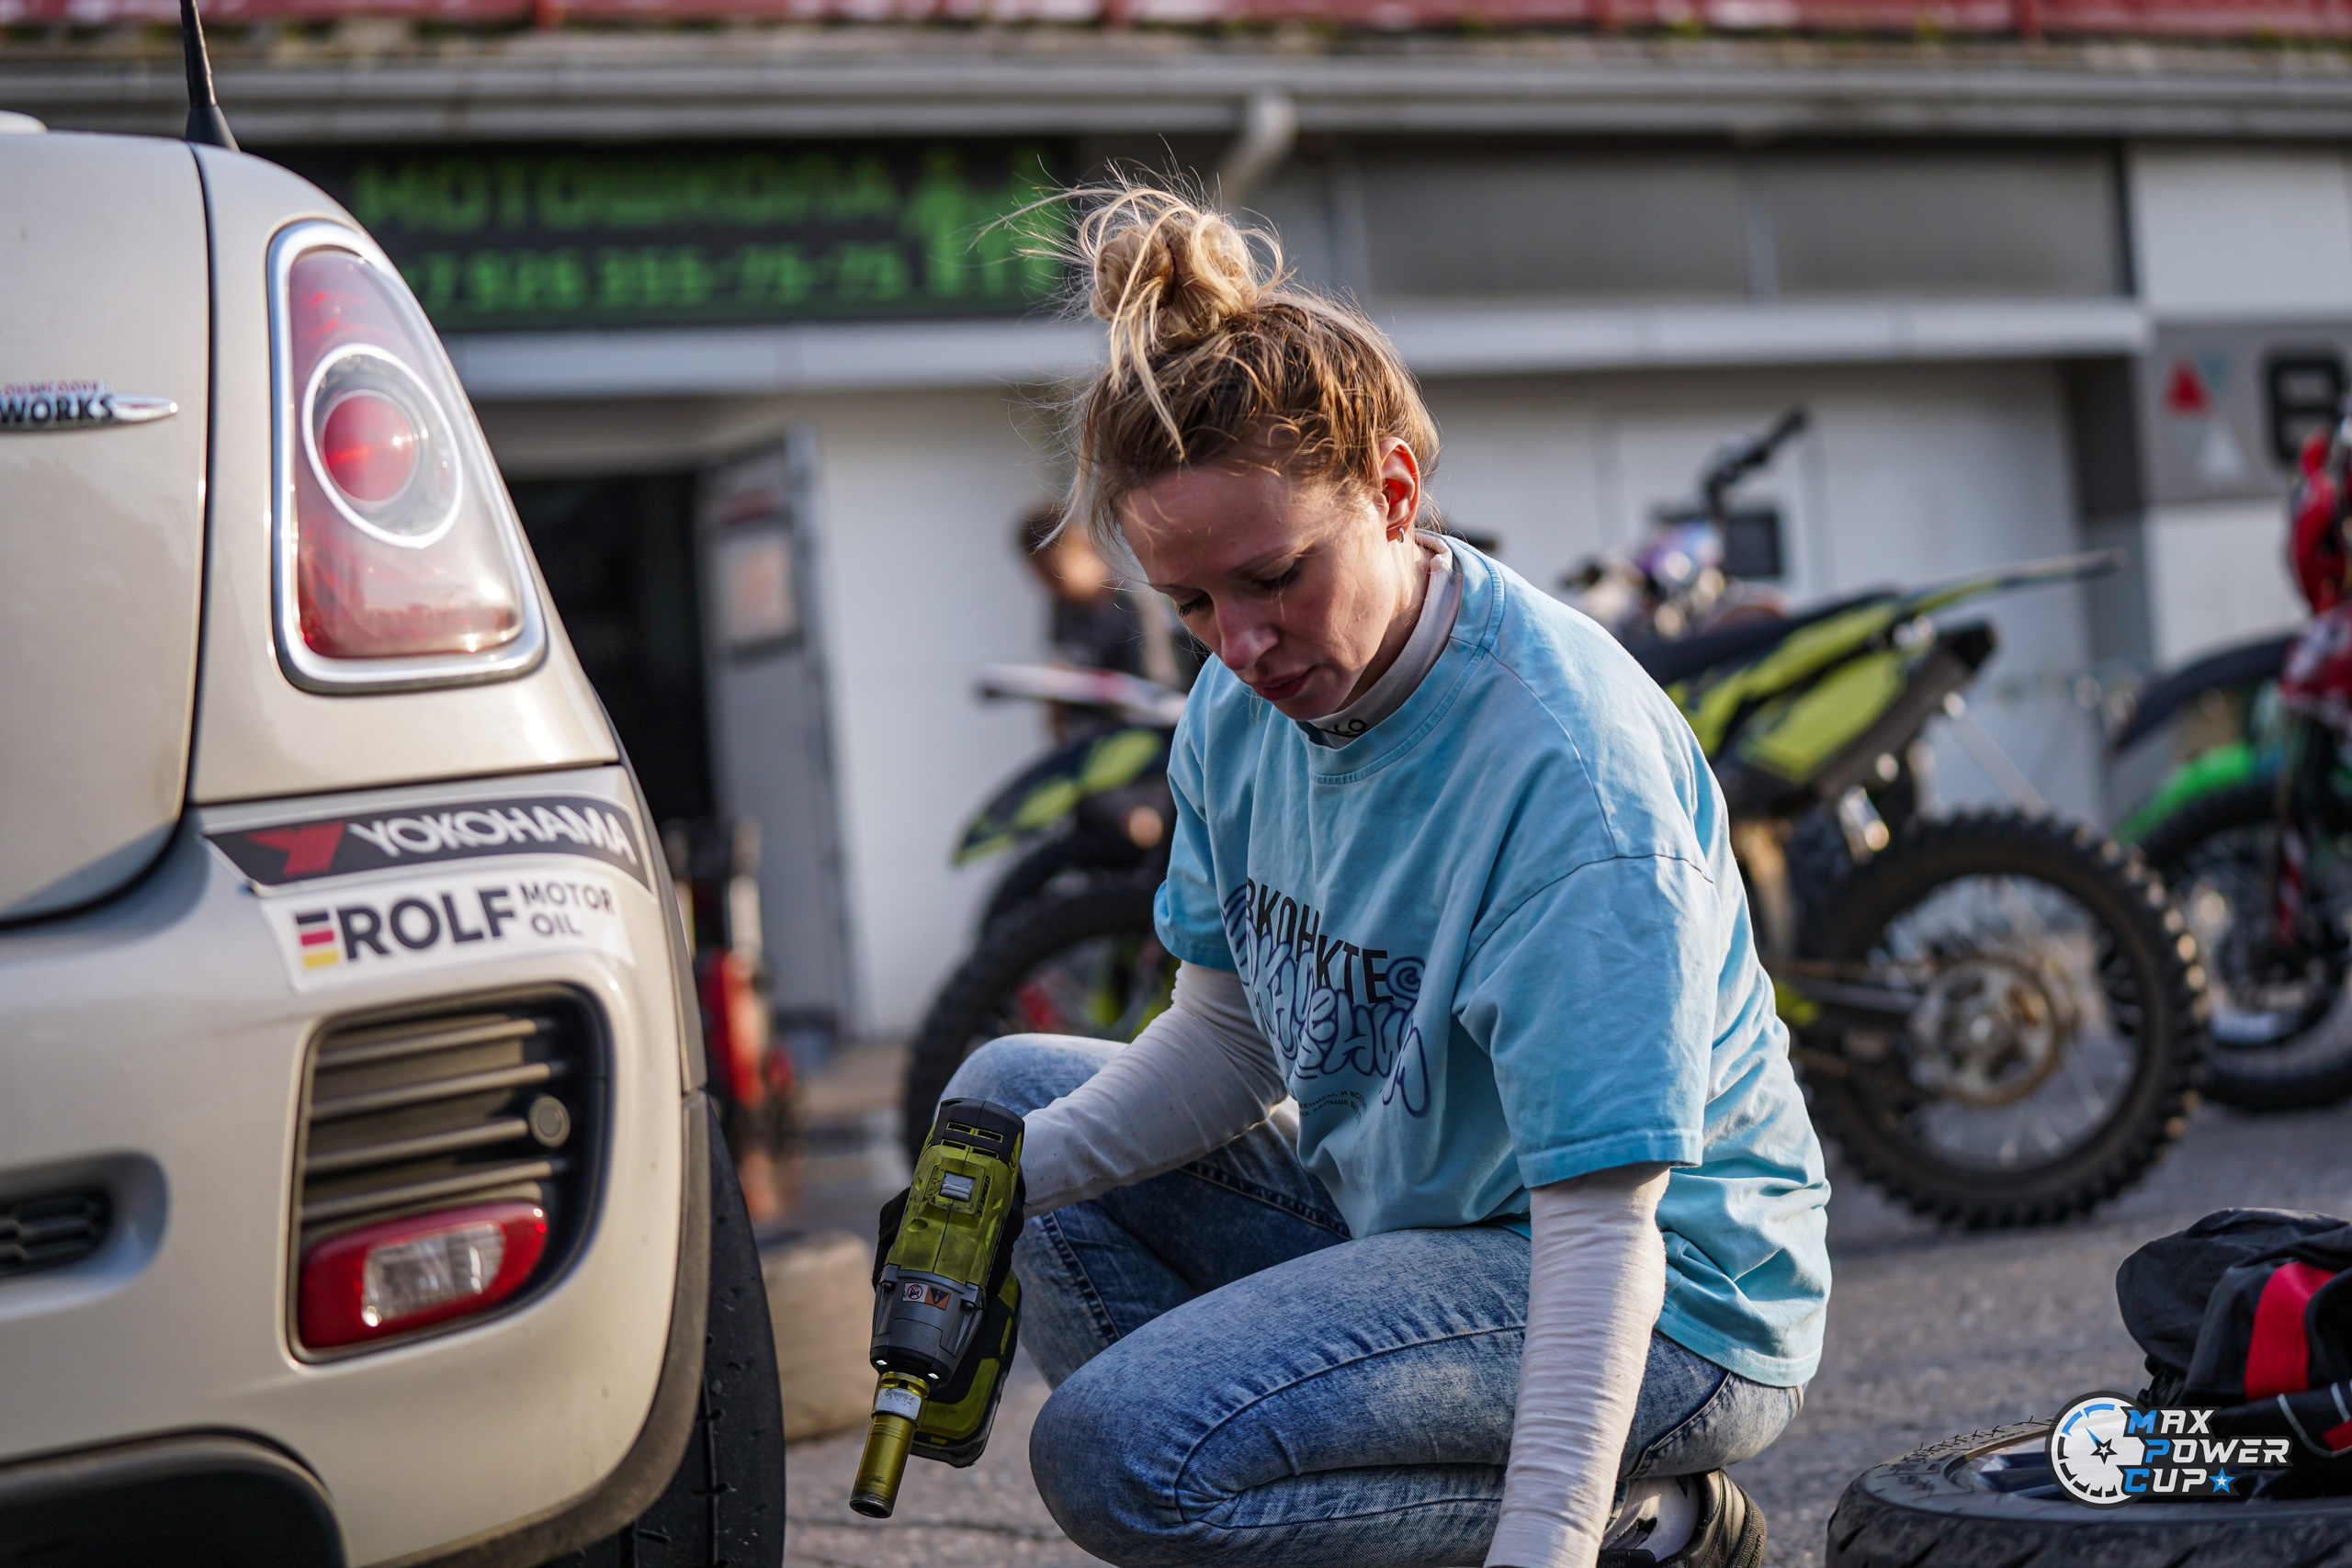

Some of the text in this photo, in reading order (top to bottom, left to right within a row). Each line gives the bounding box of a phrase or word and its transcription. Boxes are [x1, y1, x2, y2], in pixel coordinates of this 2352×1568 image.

[0, 397, 113, 423] WORKS
[350, 807, 638, 864] YOKOHAMA
[520, 883, 614, 913] MOTOR
[336, 888, 518, 961] ROLF
[531, 913, 582, 936] OIL
